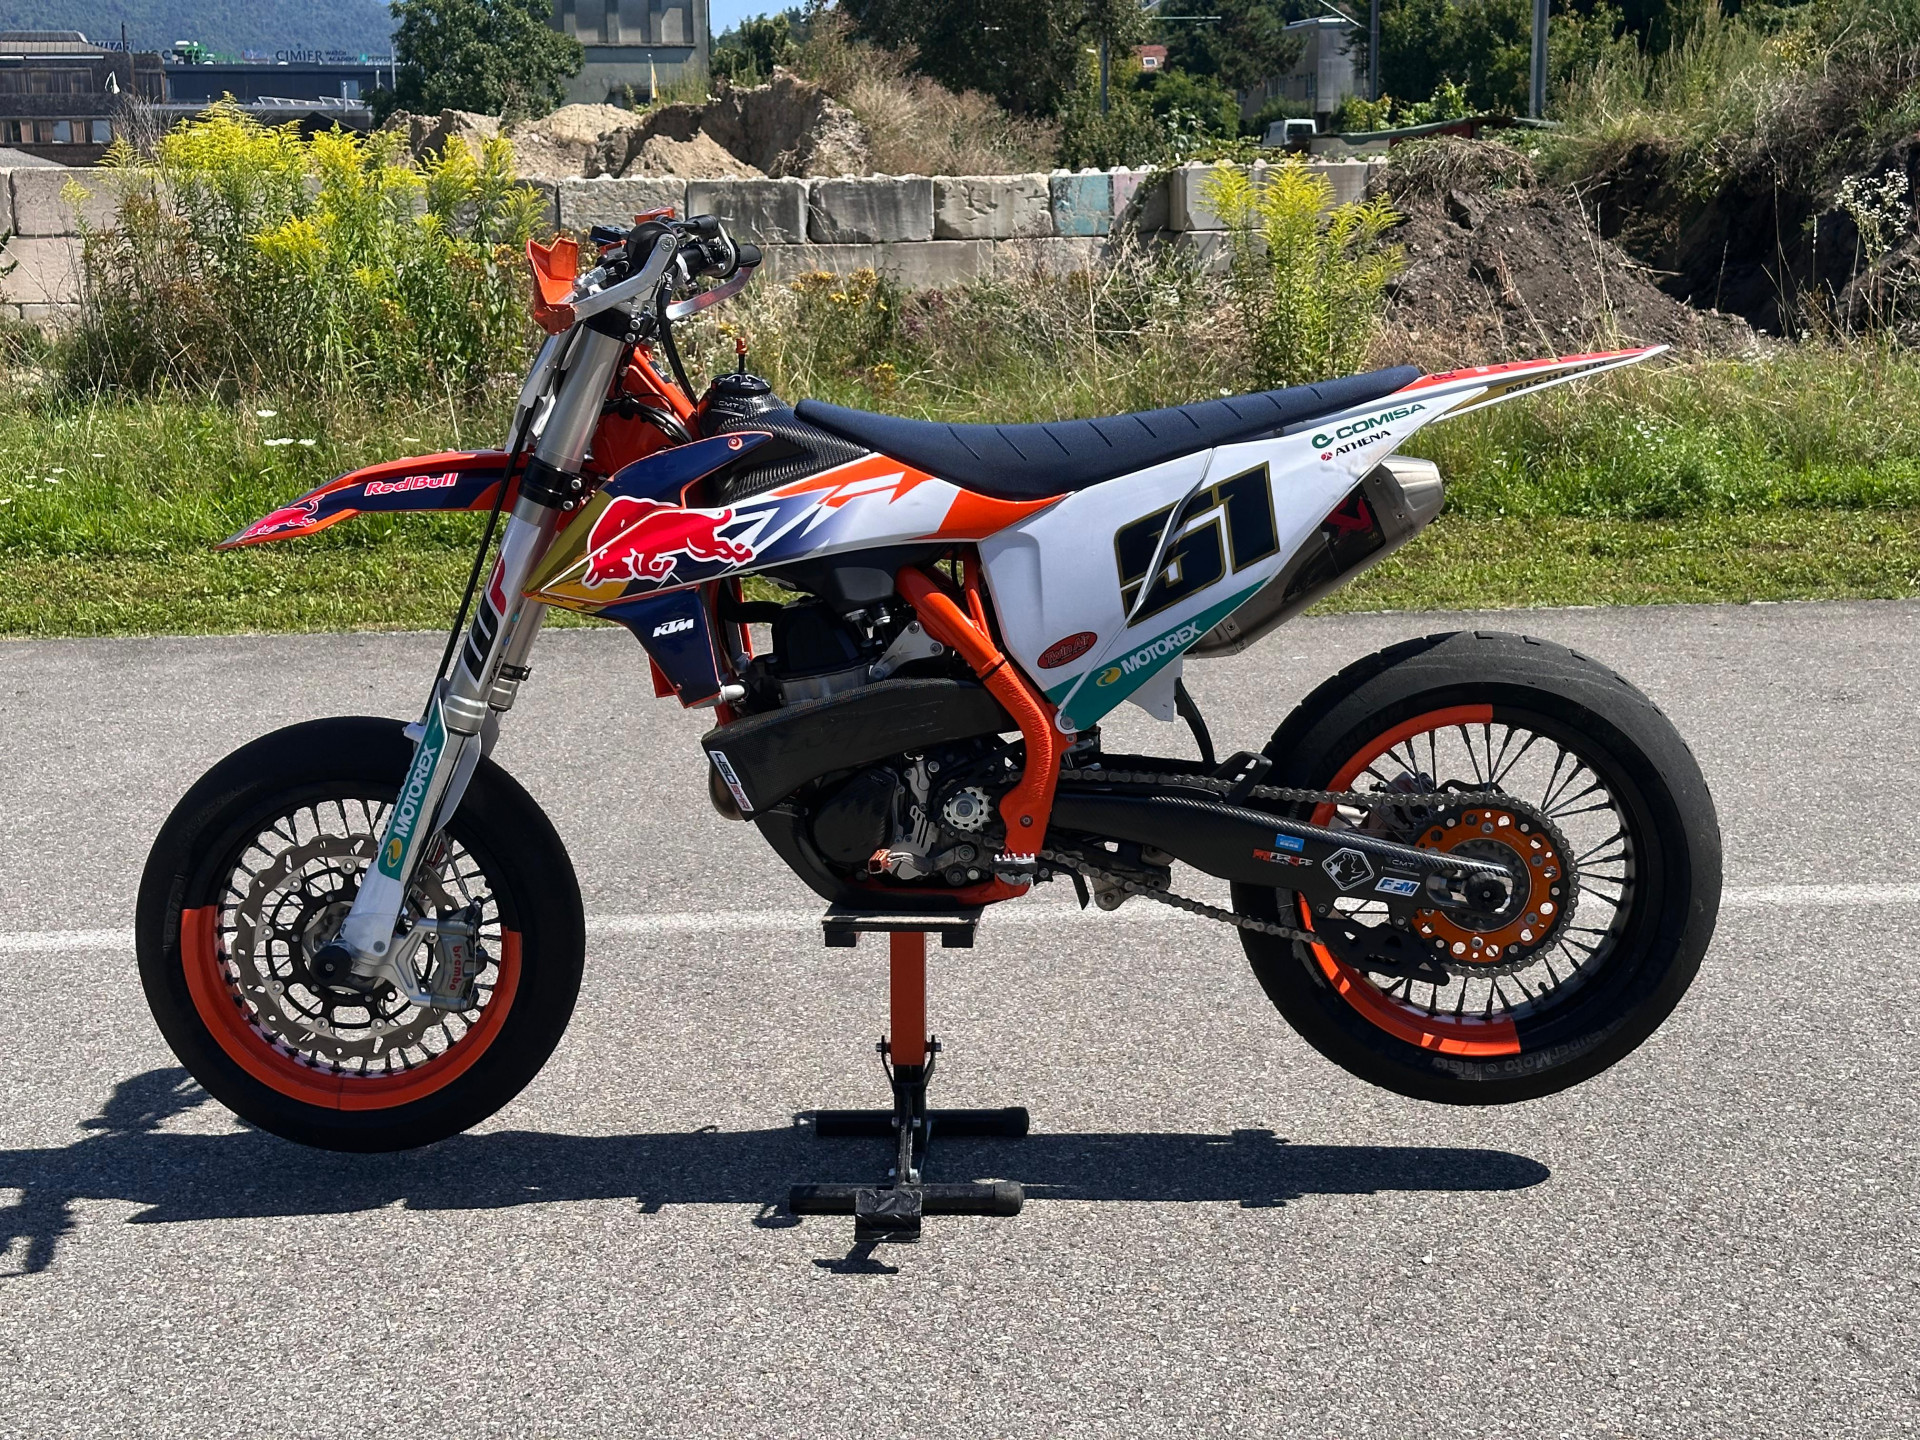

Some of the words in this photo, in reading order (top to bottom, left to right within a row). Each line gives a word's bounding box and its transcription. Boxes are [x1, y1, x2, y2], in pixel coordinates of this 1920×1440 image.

[276, 50, 323, 62] CIMIER
[1505, 360, 1607, 394] MICHELIN
[1335, 403, 1427, 439] COMISA
[1335, 430, 1391, 456] ATHENA
[364, 478, 412, 497] Red
[412, 473, 459, 489] Bull
[653, 618, 694, 637] KTM
[1119, 622, 1203, 675] MOTOREX
[393, 743, 438, 838] MOTOREX
[449, 945, 463, 991] brembo
